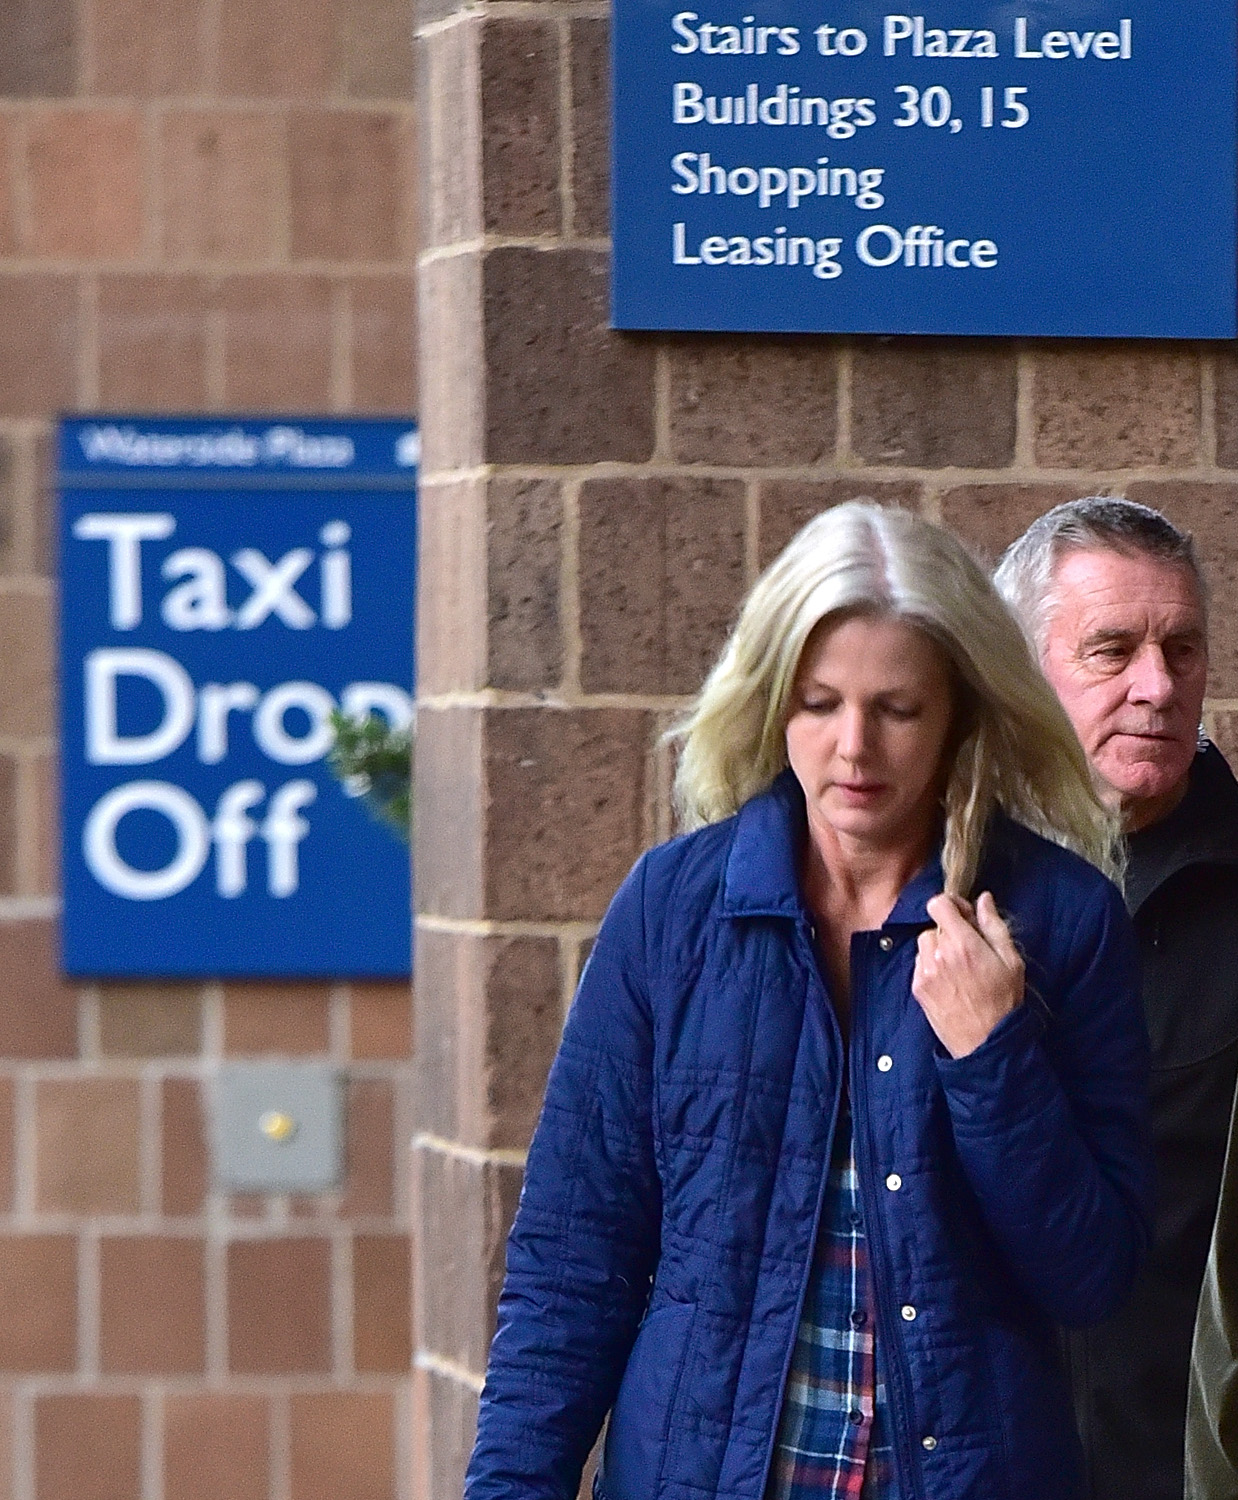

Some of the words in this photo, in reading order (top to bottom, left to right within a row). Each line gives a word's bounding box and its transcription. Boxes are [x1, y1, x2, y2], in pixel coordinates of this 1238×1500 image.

[671, 11, 800, 57] Stairs
[813, 23, 868, 57] to
[884, 15, 1000, 59] Plaza
[1014, 17, 1132, 60] Level
[672, 82, 877, 139] Buildings
[893, 85, 963, 134] 30,
[981, 86, 1030, 129] 15
[671, 152, 885, 209] Shopping
[673, 222, 843, 280] Leasing
[856, 224, 999, 268] Office
[73, 511, 352, 632] Taxi
[83, 779, 318, 901] Off
